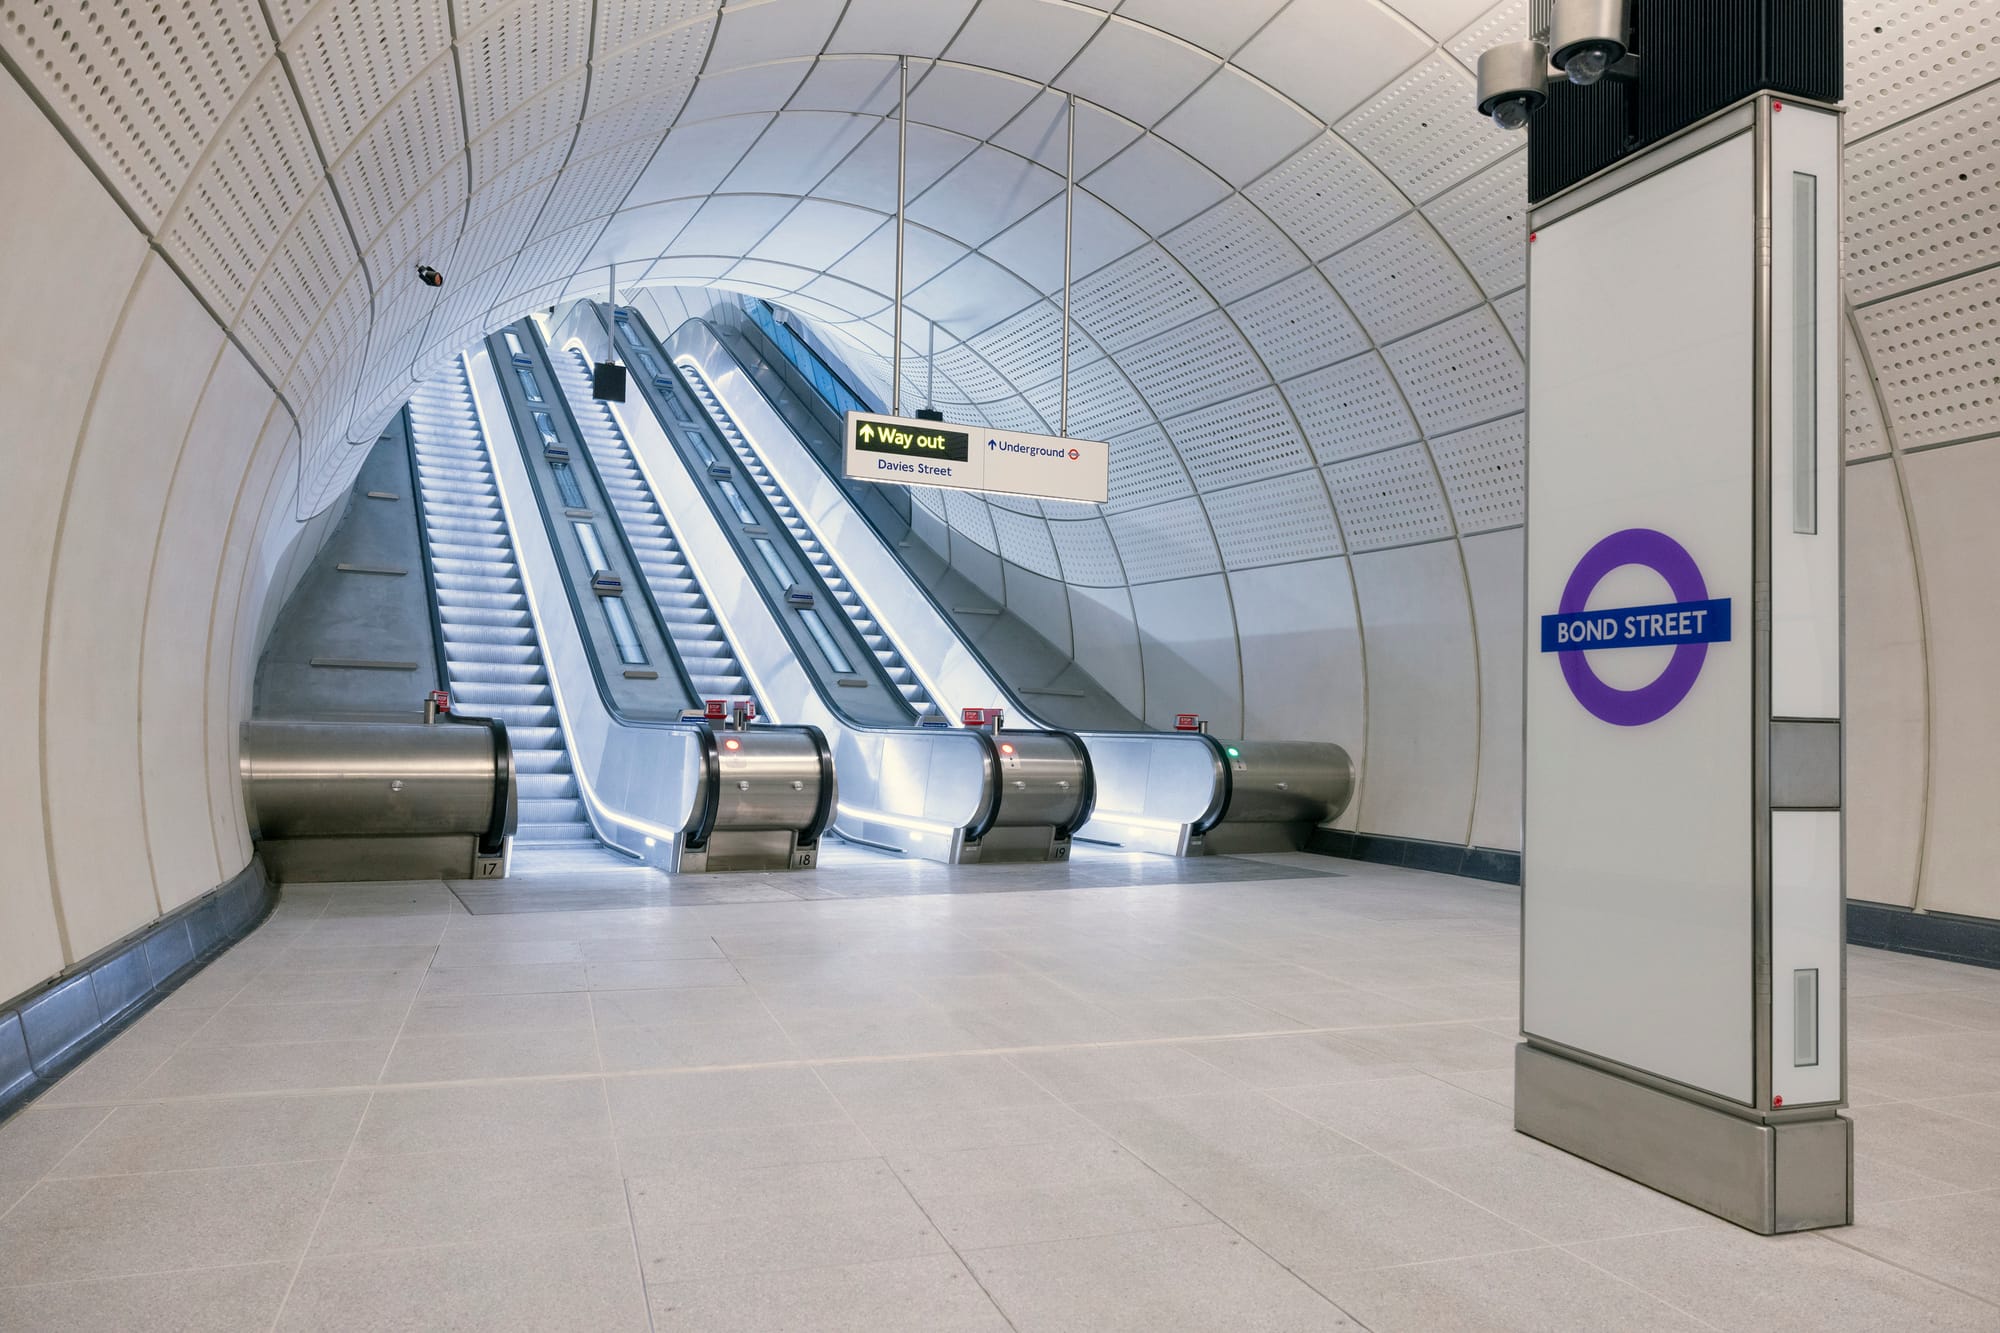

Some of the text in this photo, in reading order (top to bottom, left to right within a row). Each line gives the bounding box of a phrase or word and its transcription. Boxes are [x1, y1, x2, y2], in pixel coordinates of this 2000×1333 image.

[877, 426, 946, 450] Way out
[998, 440, 1065, 458] Underground
[878, 458, 953, 477] Davies Street
[1557, 609, 1708, 643] BOND STREET
[799, 854, 811, 866] 18
[1055, 847, 1066, 858] 19
[483, 863, 497, 876] 17
